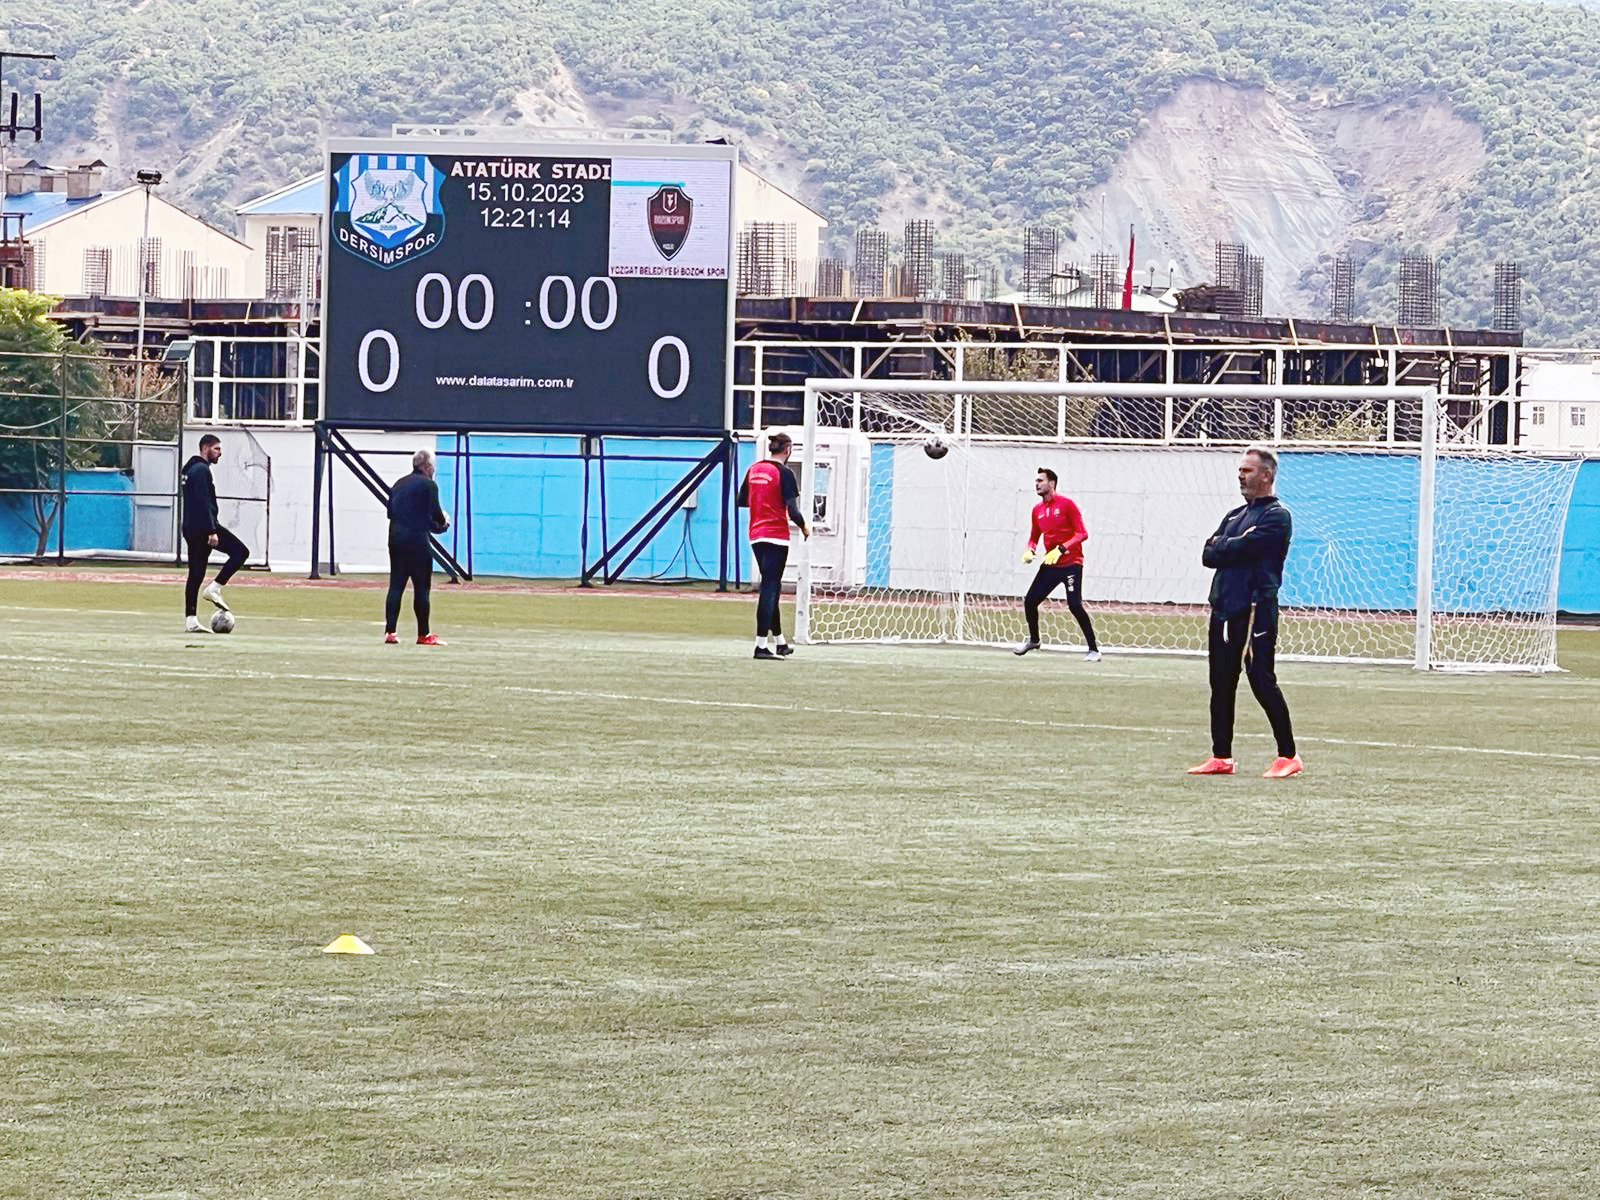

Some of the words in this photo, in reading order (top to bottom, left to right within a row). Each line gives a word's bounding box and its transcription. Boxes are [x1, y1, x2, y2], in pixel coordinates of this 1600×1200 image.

[450, 158, 541, 179] ATATÜRK
[551, 163, 611, 181] STADI
[467, 182, 585, 203] 15.10.2023
[480, 207, 571, 229] 12:21:14
[339, 226, 437, 264] DERSİMSPOR
[706, 267, 725, 277] SPOR
[357, 329, 401, 393] 0
[647, 335, 691, 399] 0
